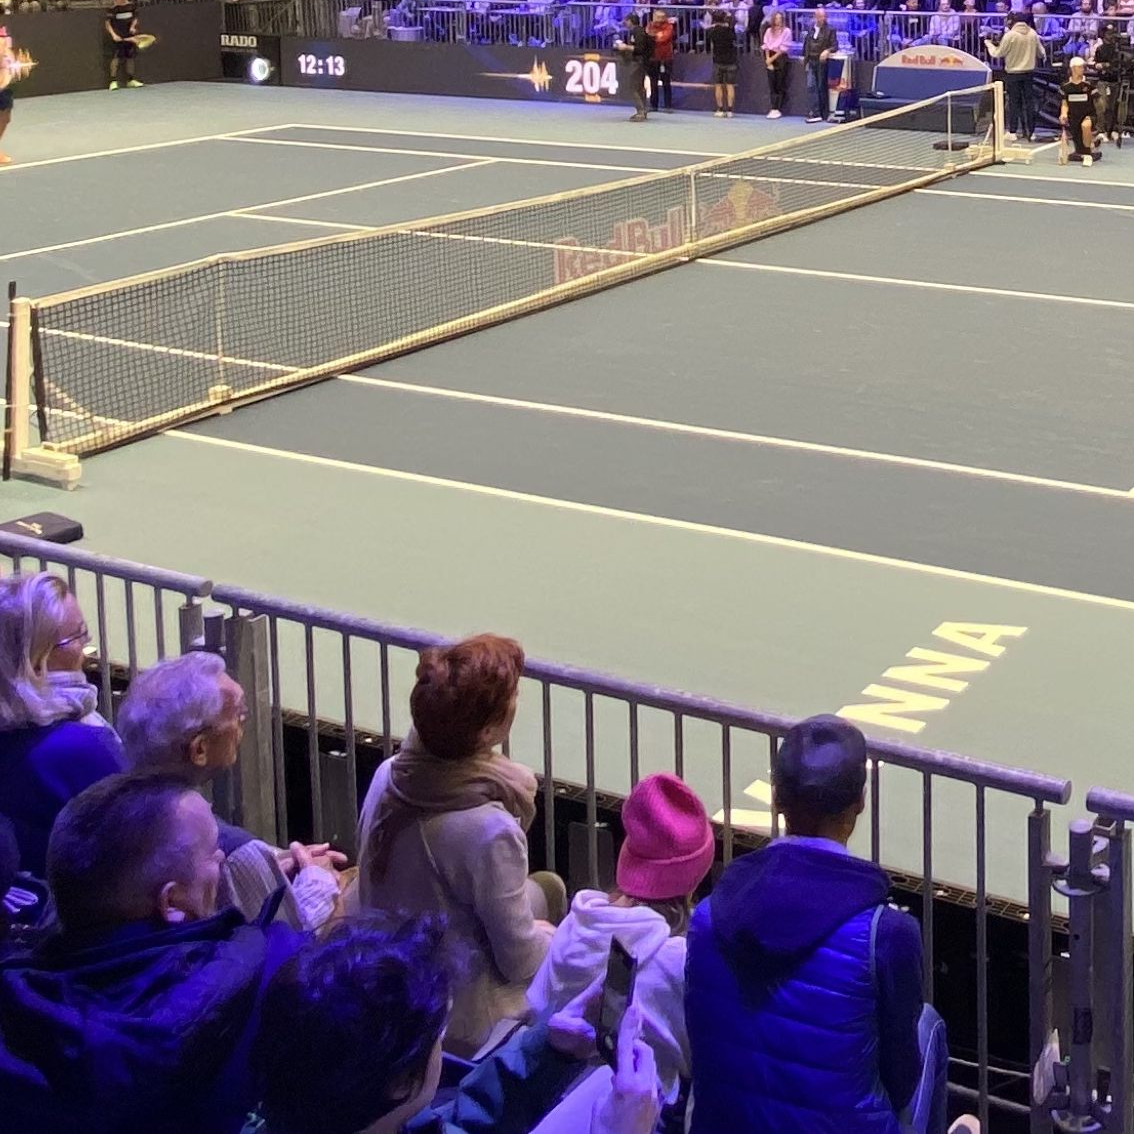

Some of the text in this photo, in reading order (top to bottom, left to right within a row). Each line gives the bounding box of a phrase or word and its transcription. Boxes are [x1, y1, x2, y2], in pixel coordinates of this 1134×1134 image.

[220, 34, 258, 47] RADO
[297, 54, 345, 76] 12:13
[901, 54, 936, 66] Red Bull
[564, 59, 619, 95] 204
